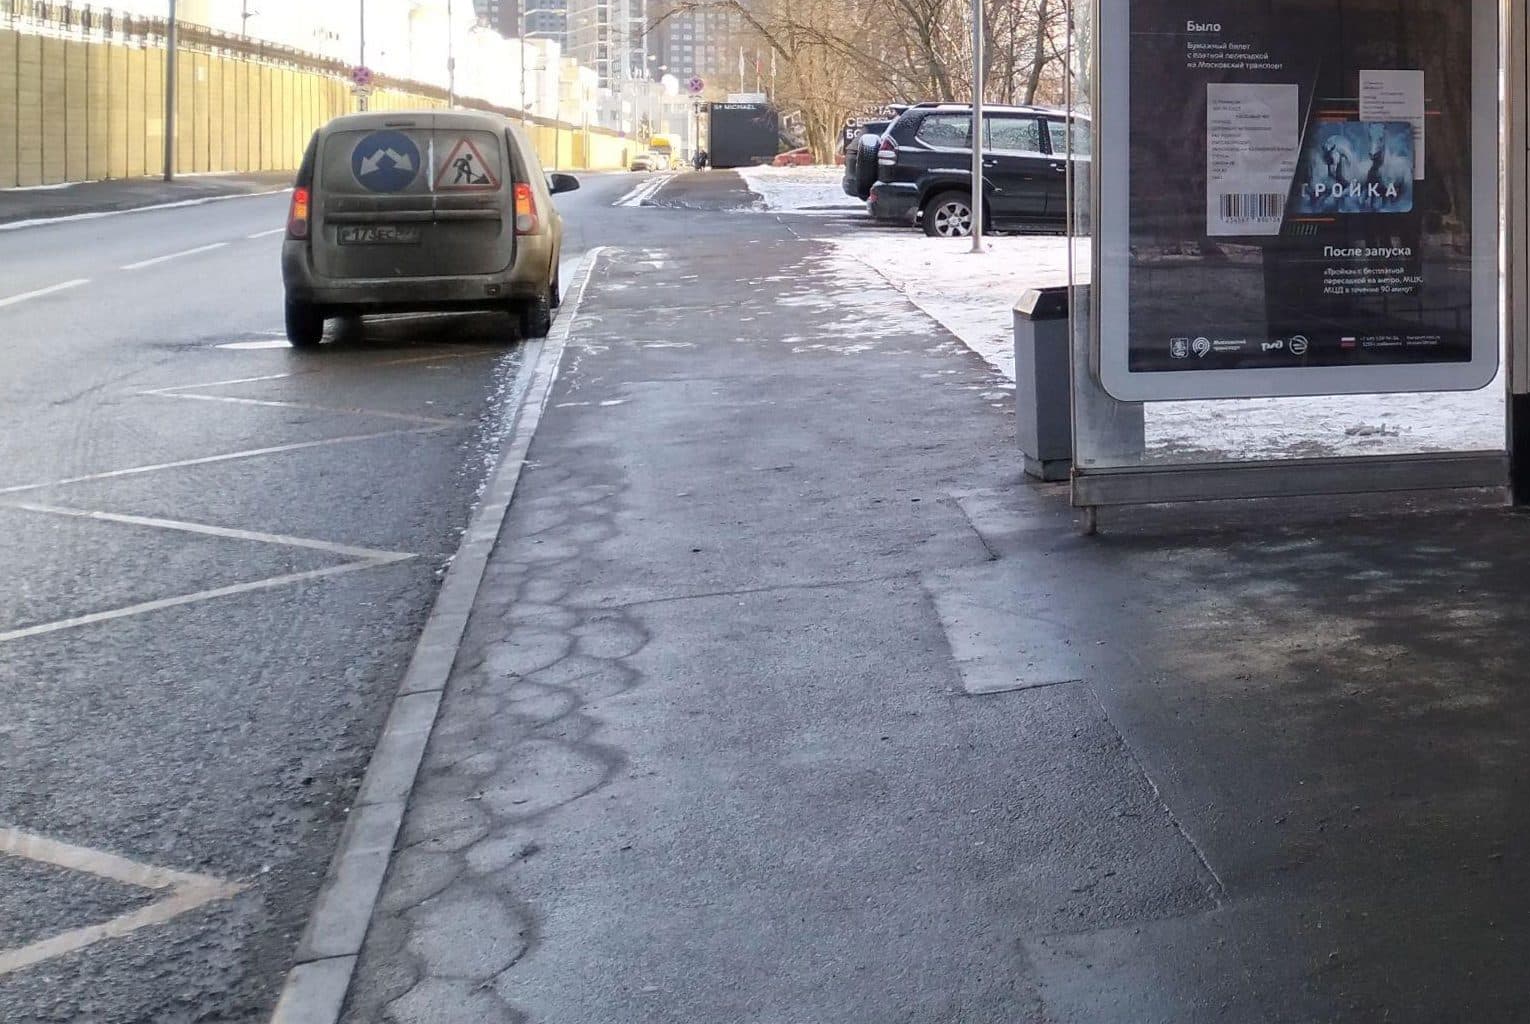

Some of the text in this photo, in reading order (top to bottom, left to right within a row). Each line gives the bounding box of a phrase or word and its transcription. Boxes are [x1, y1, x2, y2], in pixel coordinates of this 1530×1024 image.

[1187, 20, 1221, 32] Было
[1324, 246, 1411, 258] После запуска
